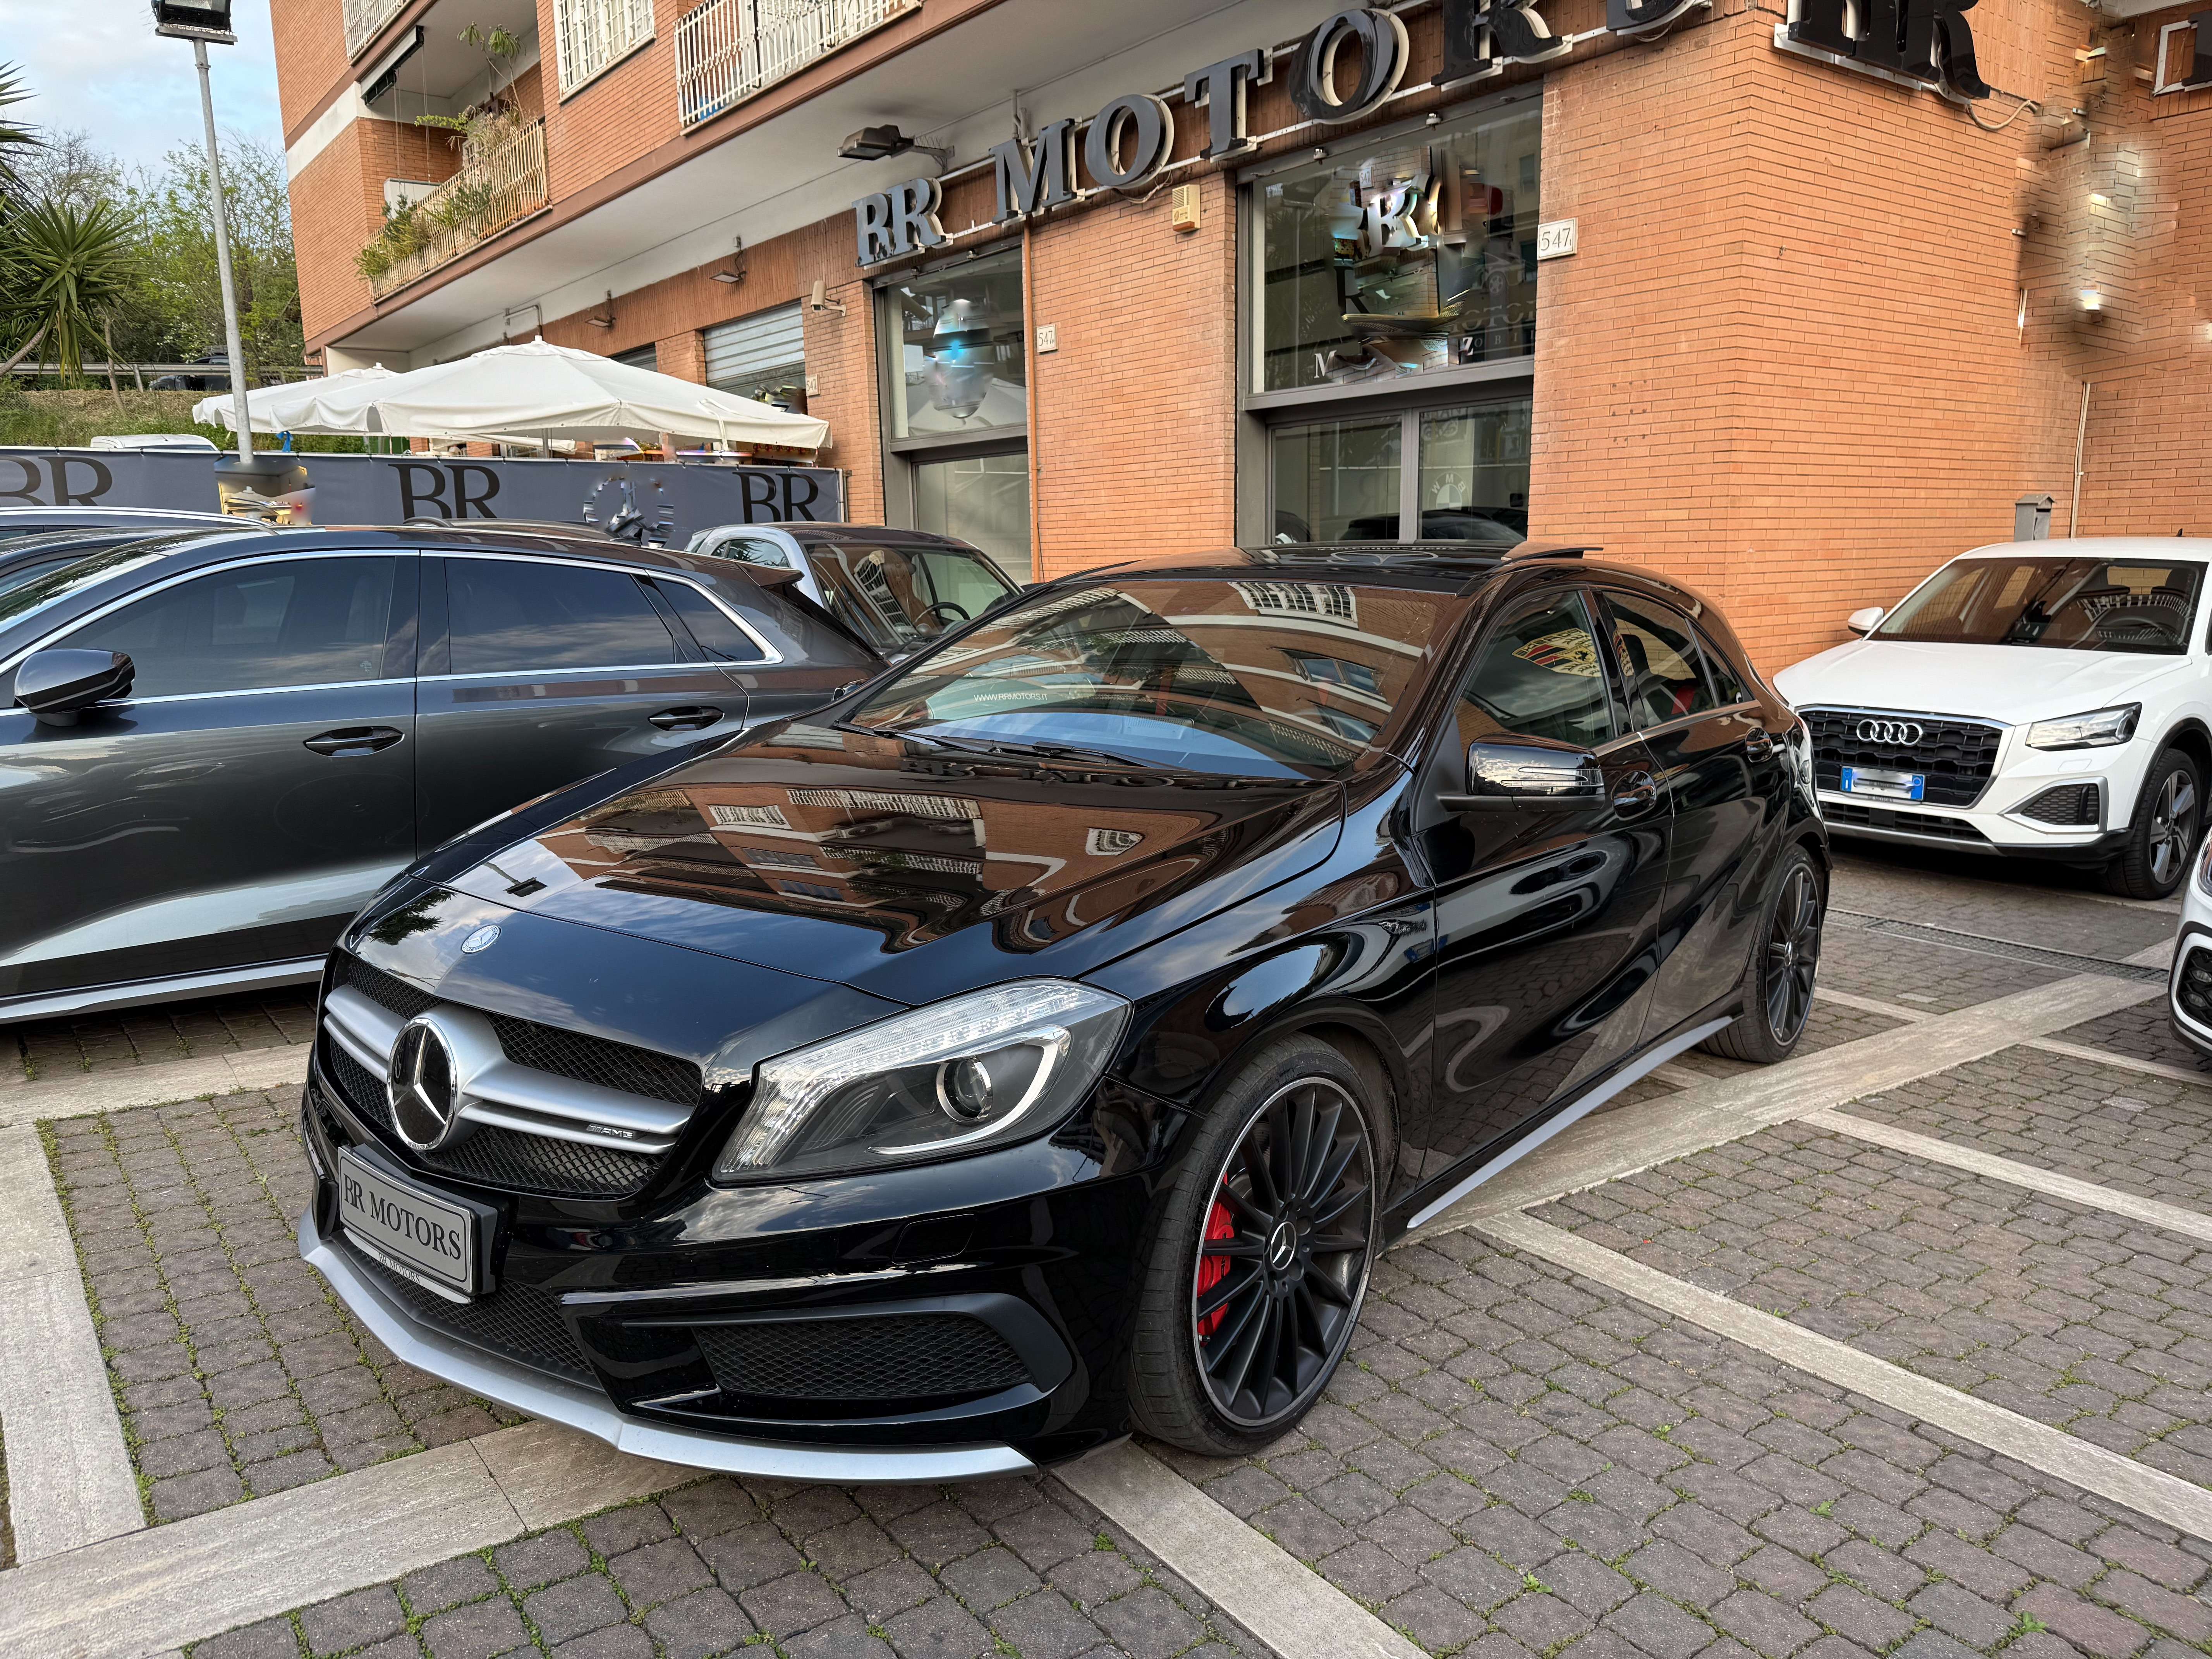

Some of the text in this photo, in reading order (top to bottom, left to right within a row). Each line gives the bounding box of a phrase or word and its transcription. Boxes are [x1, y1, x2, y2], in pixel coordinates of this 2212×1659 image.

[988, 0, 1696, 225] MOTOR
[973, 693, 1048, 701] WWW.RRMOTORS.IT
[369, 1191, 461, 1260] MOTORS
[389, 1259, 420, 1284] MOTORS
